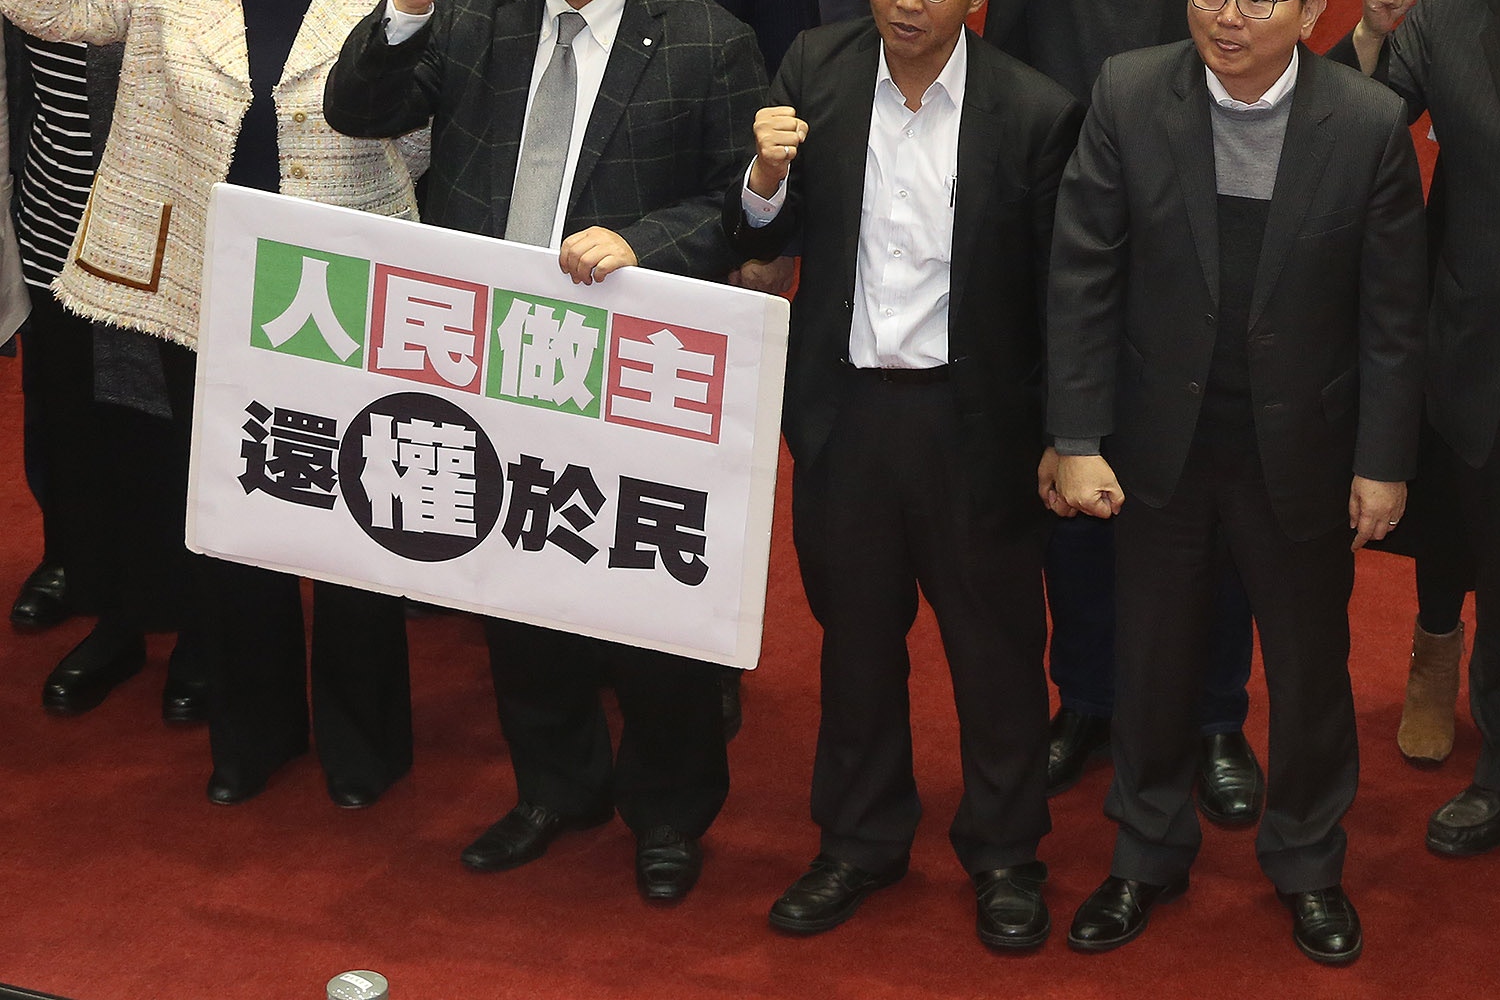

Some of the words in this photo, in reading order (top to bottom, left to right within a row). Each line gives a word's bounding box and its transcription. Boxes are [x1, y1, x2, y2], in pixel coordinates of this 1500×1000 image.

[261, 256, 715, 437] 人民做主
[236, 400, 709, 587] 還權於民
